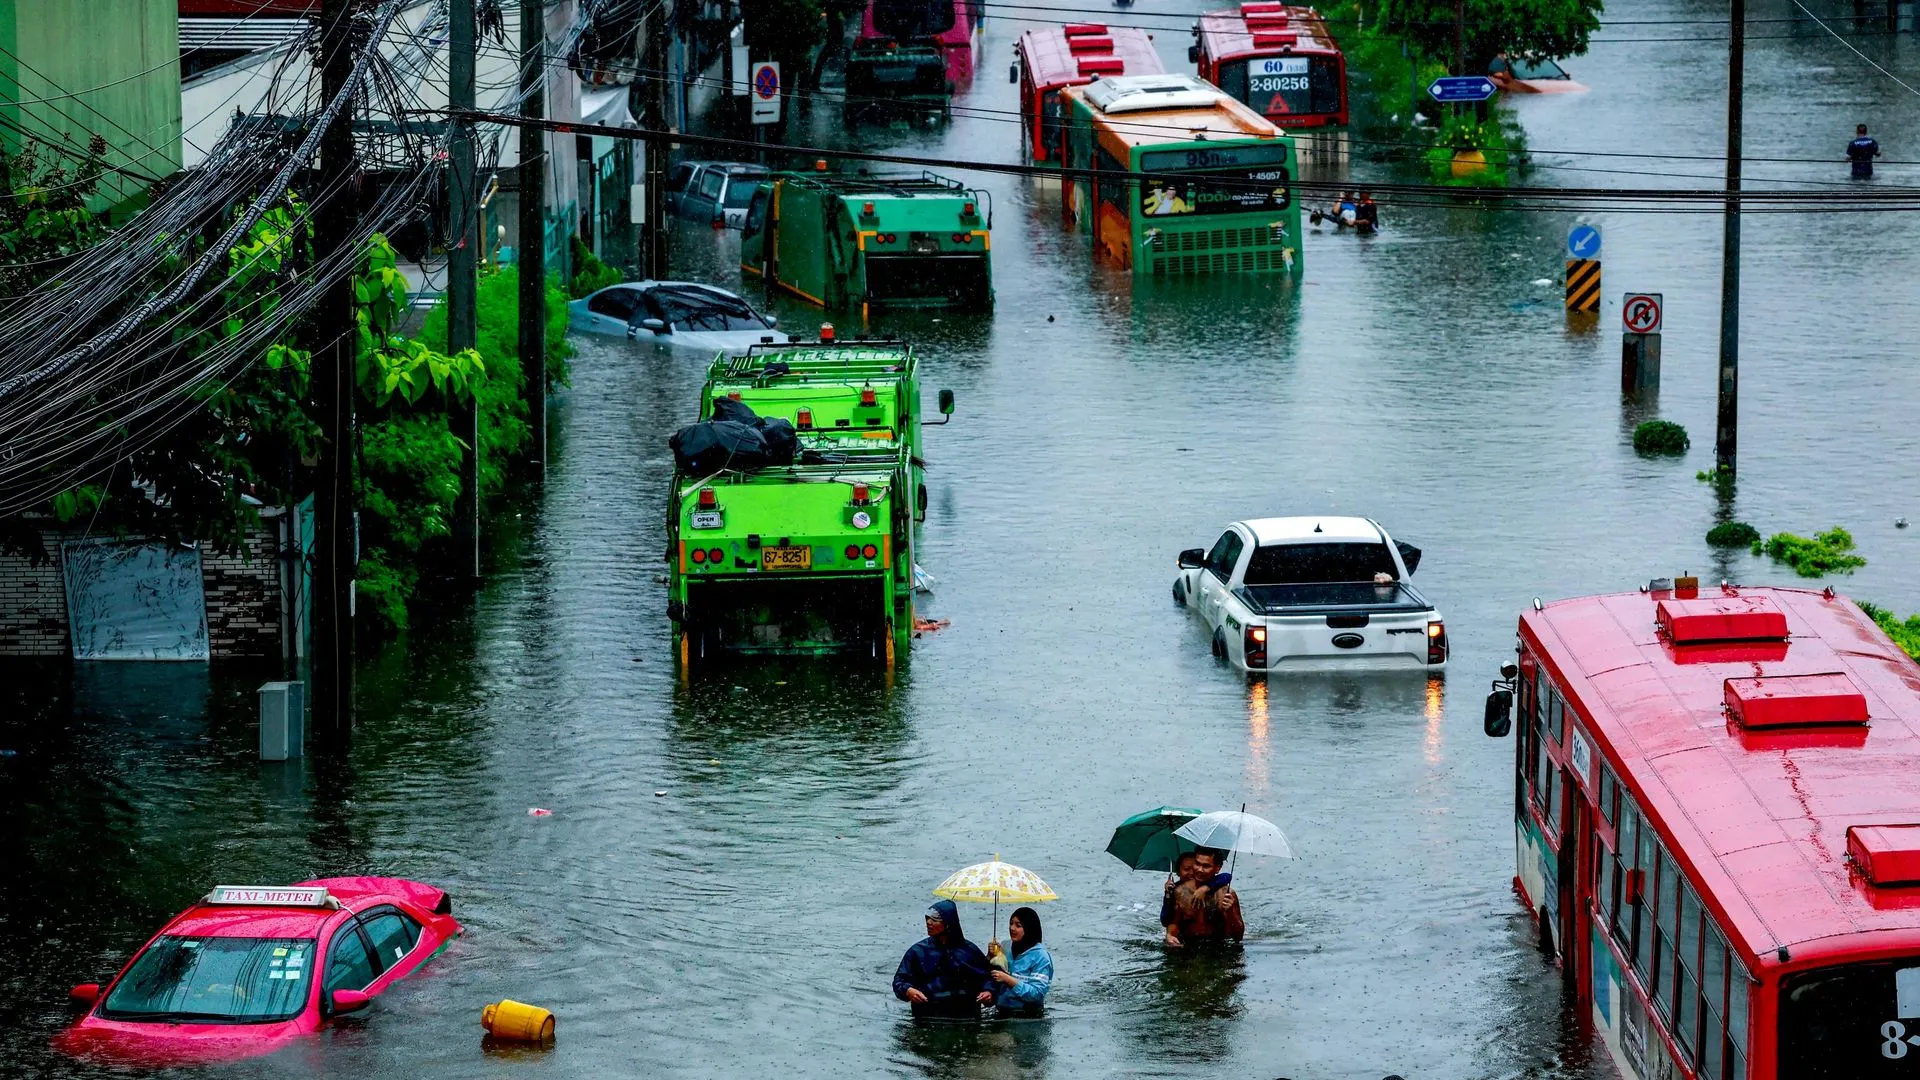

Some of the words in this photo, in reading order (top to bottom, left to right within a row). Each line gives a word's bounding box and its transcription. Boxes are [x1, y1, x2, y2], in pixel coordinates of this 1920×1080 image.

[1264, 60, 1283, 73] 60
[1250, 77, 1309, 92] 2-80256
[1248, 171, 1281, 180] 1-45057
[764, 551, 807, 563] 67-8251
[224, 891, 314, 902] TAXI-METER
